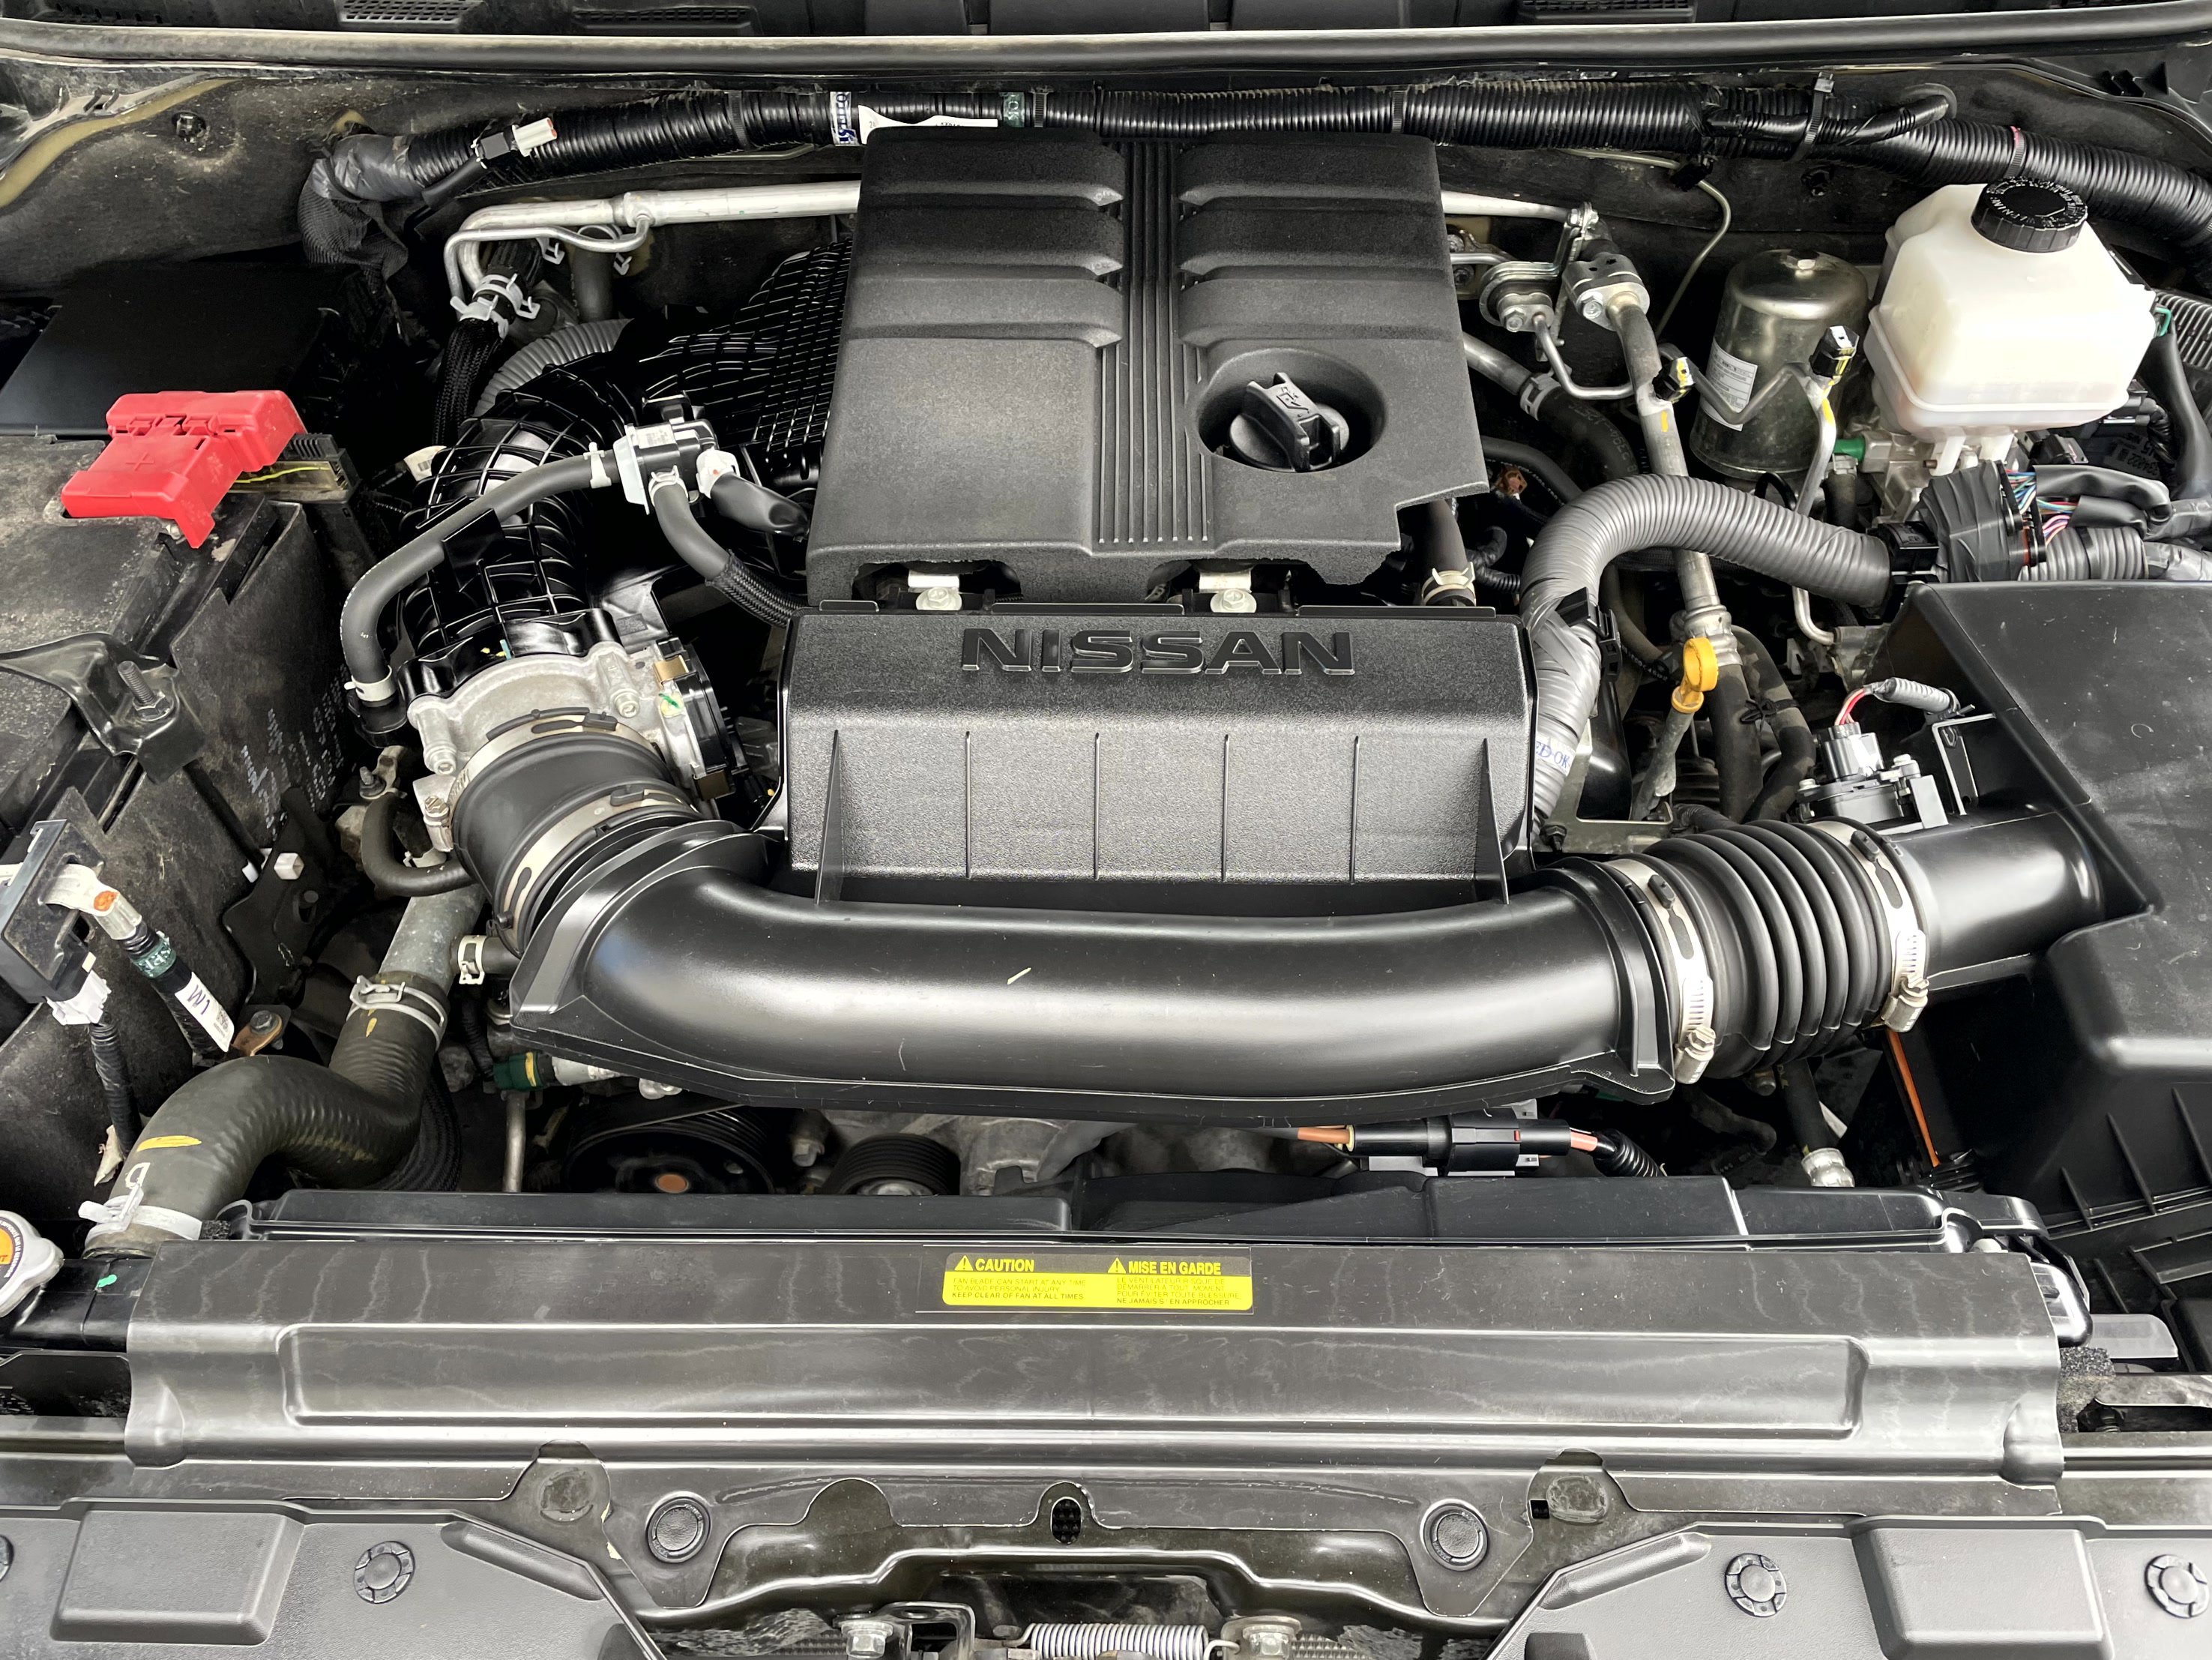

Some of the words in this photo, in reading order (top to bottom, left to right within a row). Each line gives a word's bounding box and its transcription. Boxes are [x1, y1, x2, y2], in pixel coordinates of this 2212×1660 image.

[962, 628, 1355, 675] NISSAN
[974, 1258, 1034, 1272] CAUTION
[1128, 1261, 1157, 1274] MISE
[1160, 1262, 1177, 1275] EN
[1179, 1262, 1221, 1275] GARDE
